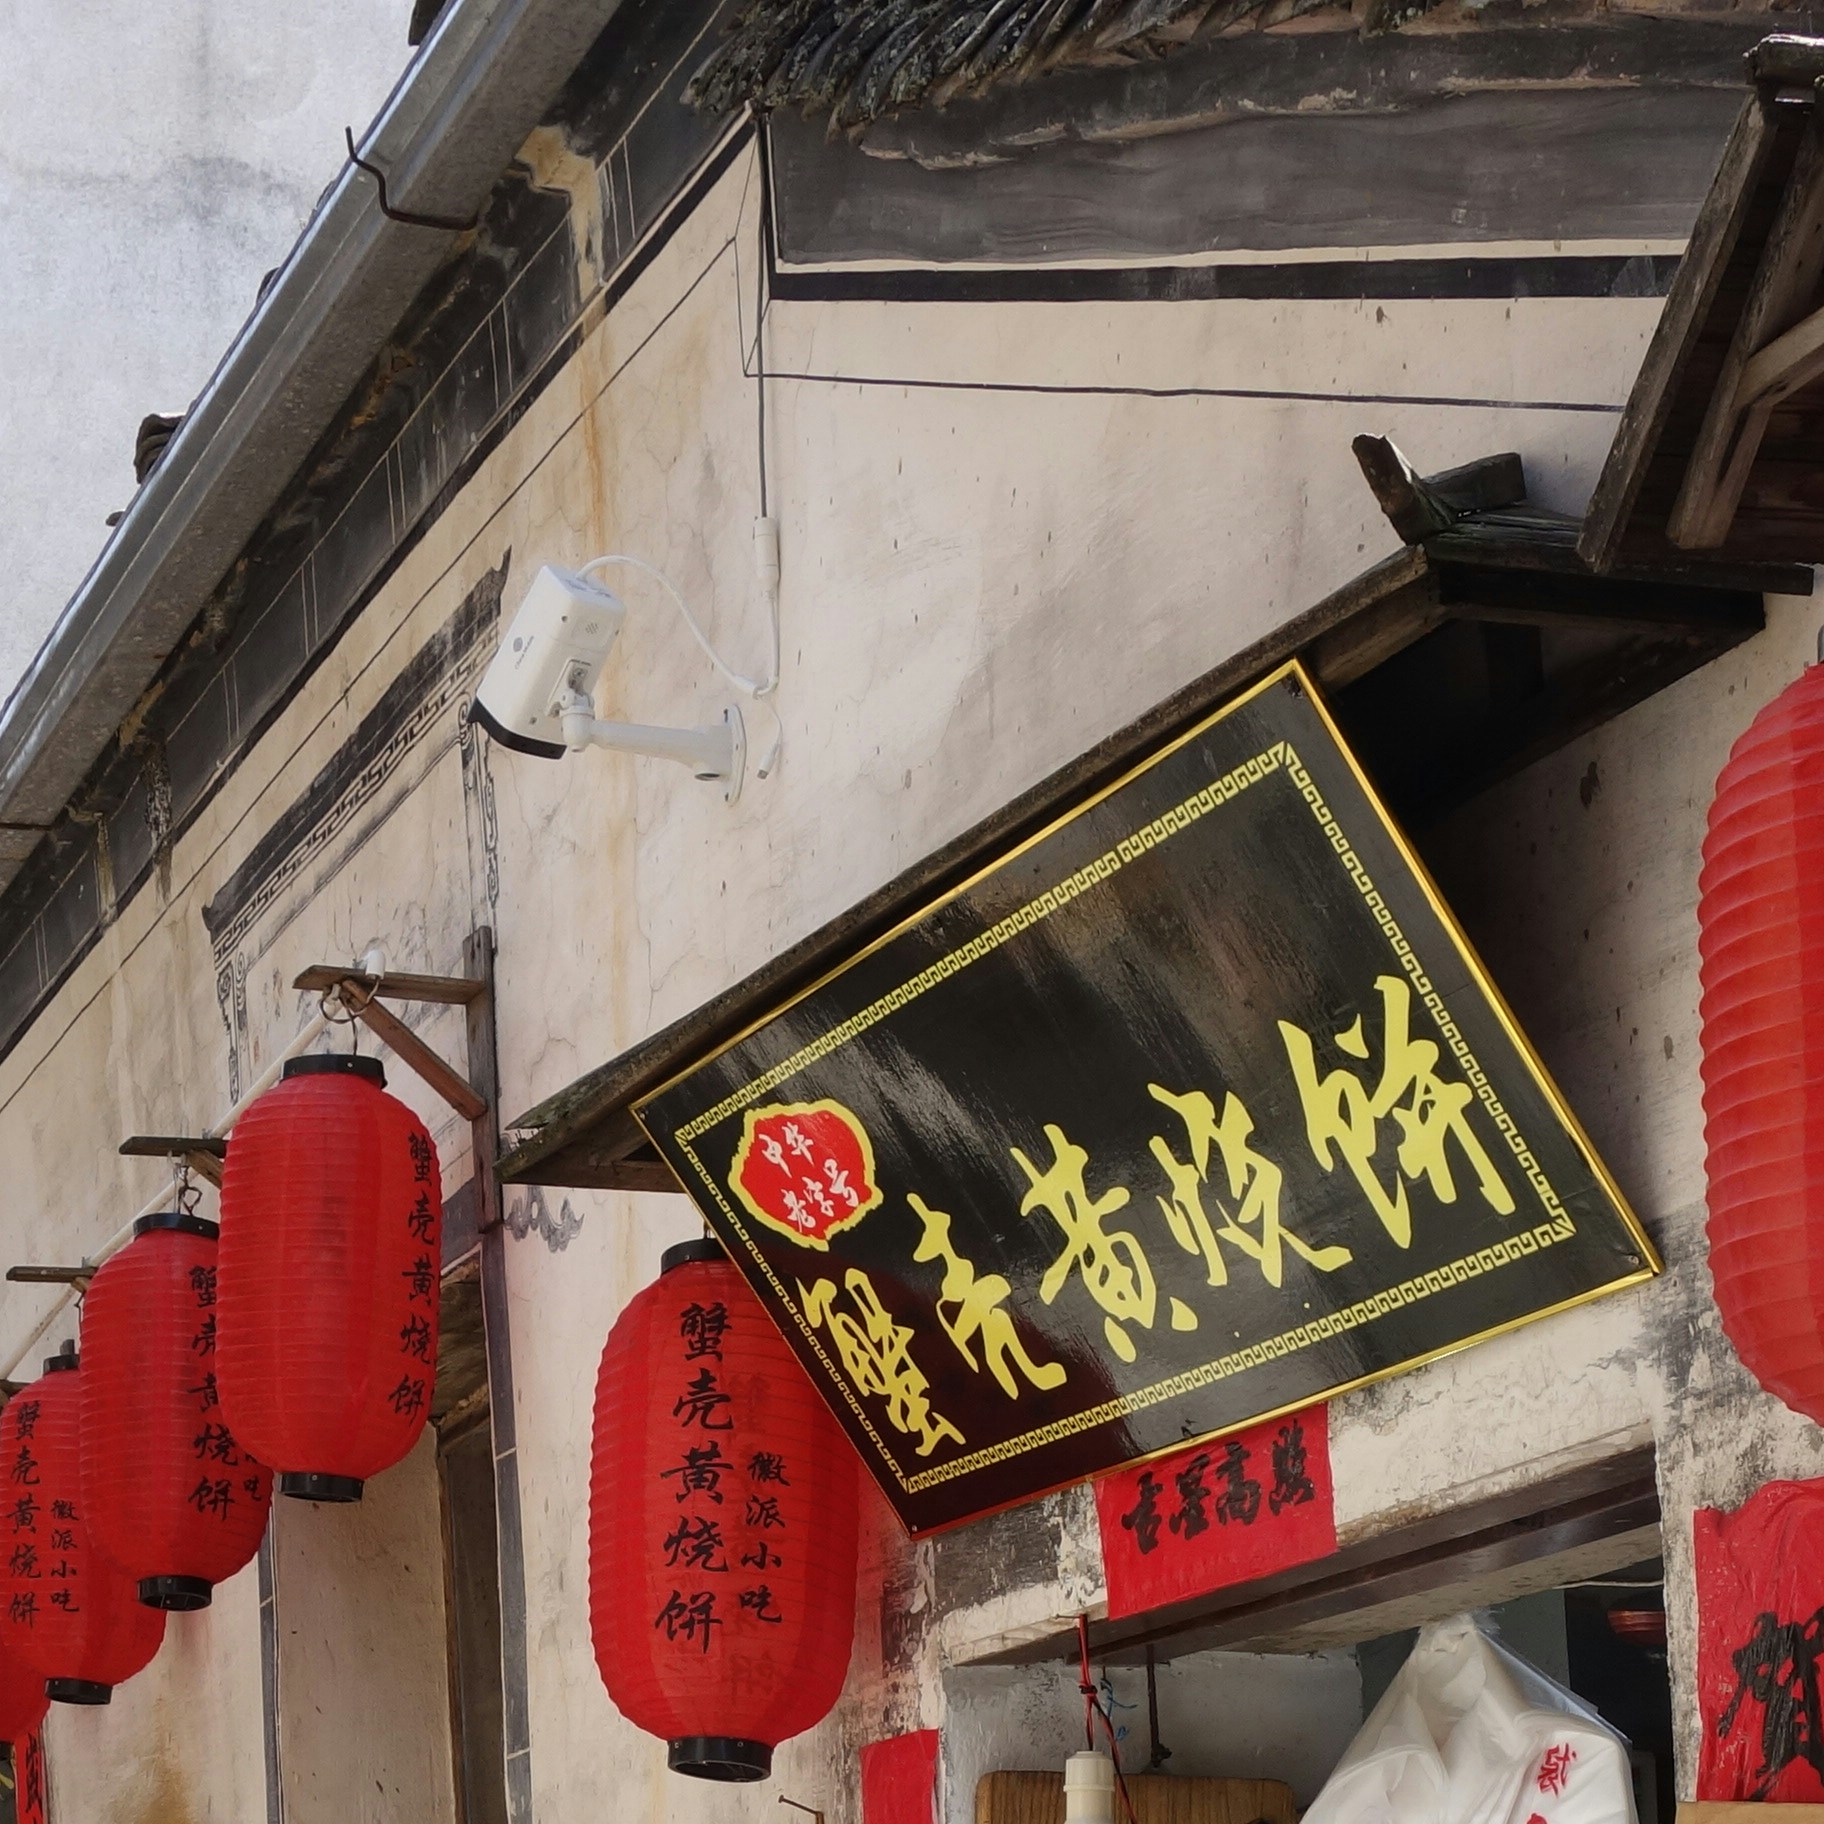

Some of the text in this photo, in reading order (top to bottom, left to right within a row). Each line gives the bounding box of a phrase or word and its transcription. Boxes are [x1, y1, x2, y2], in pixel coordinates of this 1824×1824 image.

[387, 1132, 438, 1435] 蟹壳黄烧饼
[8, 1400, 43, 1629] 蟹壳黄烧饼
[49, 1499, 80, 1613] 徽派小吃
[655, 1301, 735, 1655] 蟹壳黄烧饼
[738, 1451, 792, 1624] 徽派小吃
